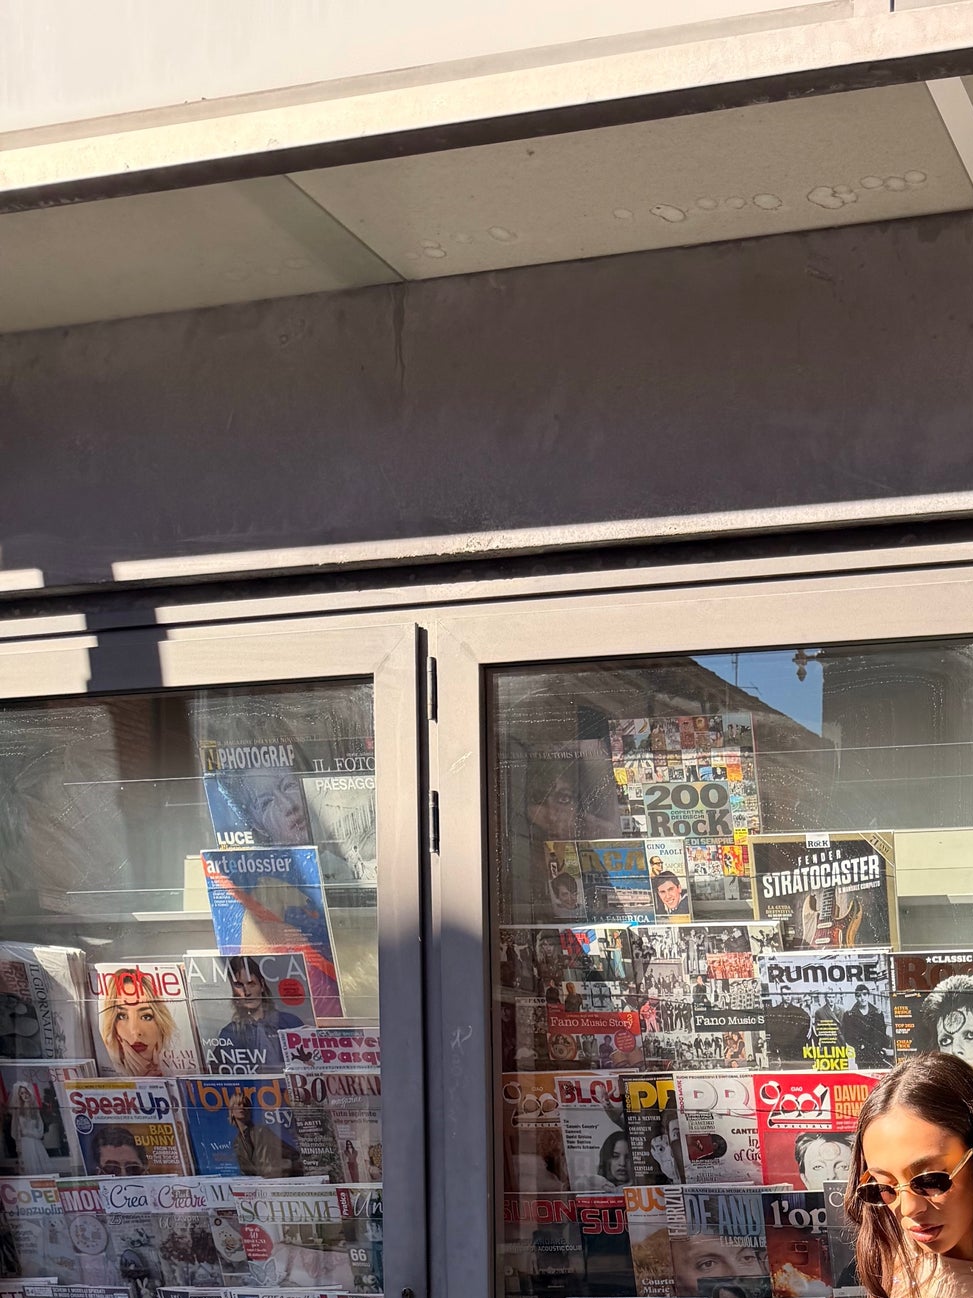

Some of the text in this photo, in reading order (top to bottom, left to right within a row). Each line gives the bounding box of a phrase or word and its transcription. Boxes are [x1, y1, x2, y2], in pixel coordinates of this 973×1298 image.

[313, 759, 330, 772] IL
[645, 783, 728, 811] 200
[217, 831, 254, 845] LUCE
[660, 848, 683, 856] PAOLI
[798, 849, 841, 866] FENDER
[763, 854, 881, 899] STRATOCASTER
[931, 955, 973, 964] CLASSIC
[187, 956, 306, 983] AMICA
[768, 964, 879, 983] RUMORE
[88, 965, 182, 1006] unghie
[551, 1017, 634, 1030] Fano Music Story
[696, 1015, 757, 1027] Fano Music
[202, 1038, 234, 1047] MODA
[206, 1049, 266, 1064] A NEW
[803, 1045, 856, 1059] KILLING
[813, 1058, 849, 1071] JOKE
[834, 1085, 869, 1101] DAVID
[69, 1091, 171, 1120] SpeakUp
[150, 1124, 173, 1135] BAD
[134, 1135, 175, 1146] BUNNY
